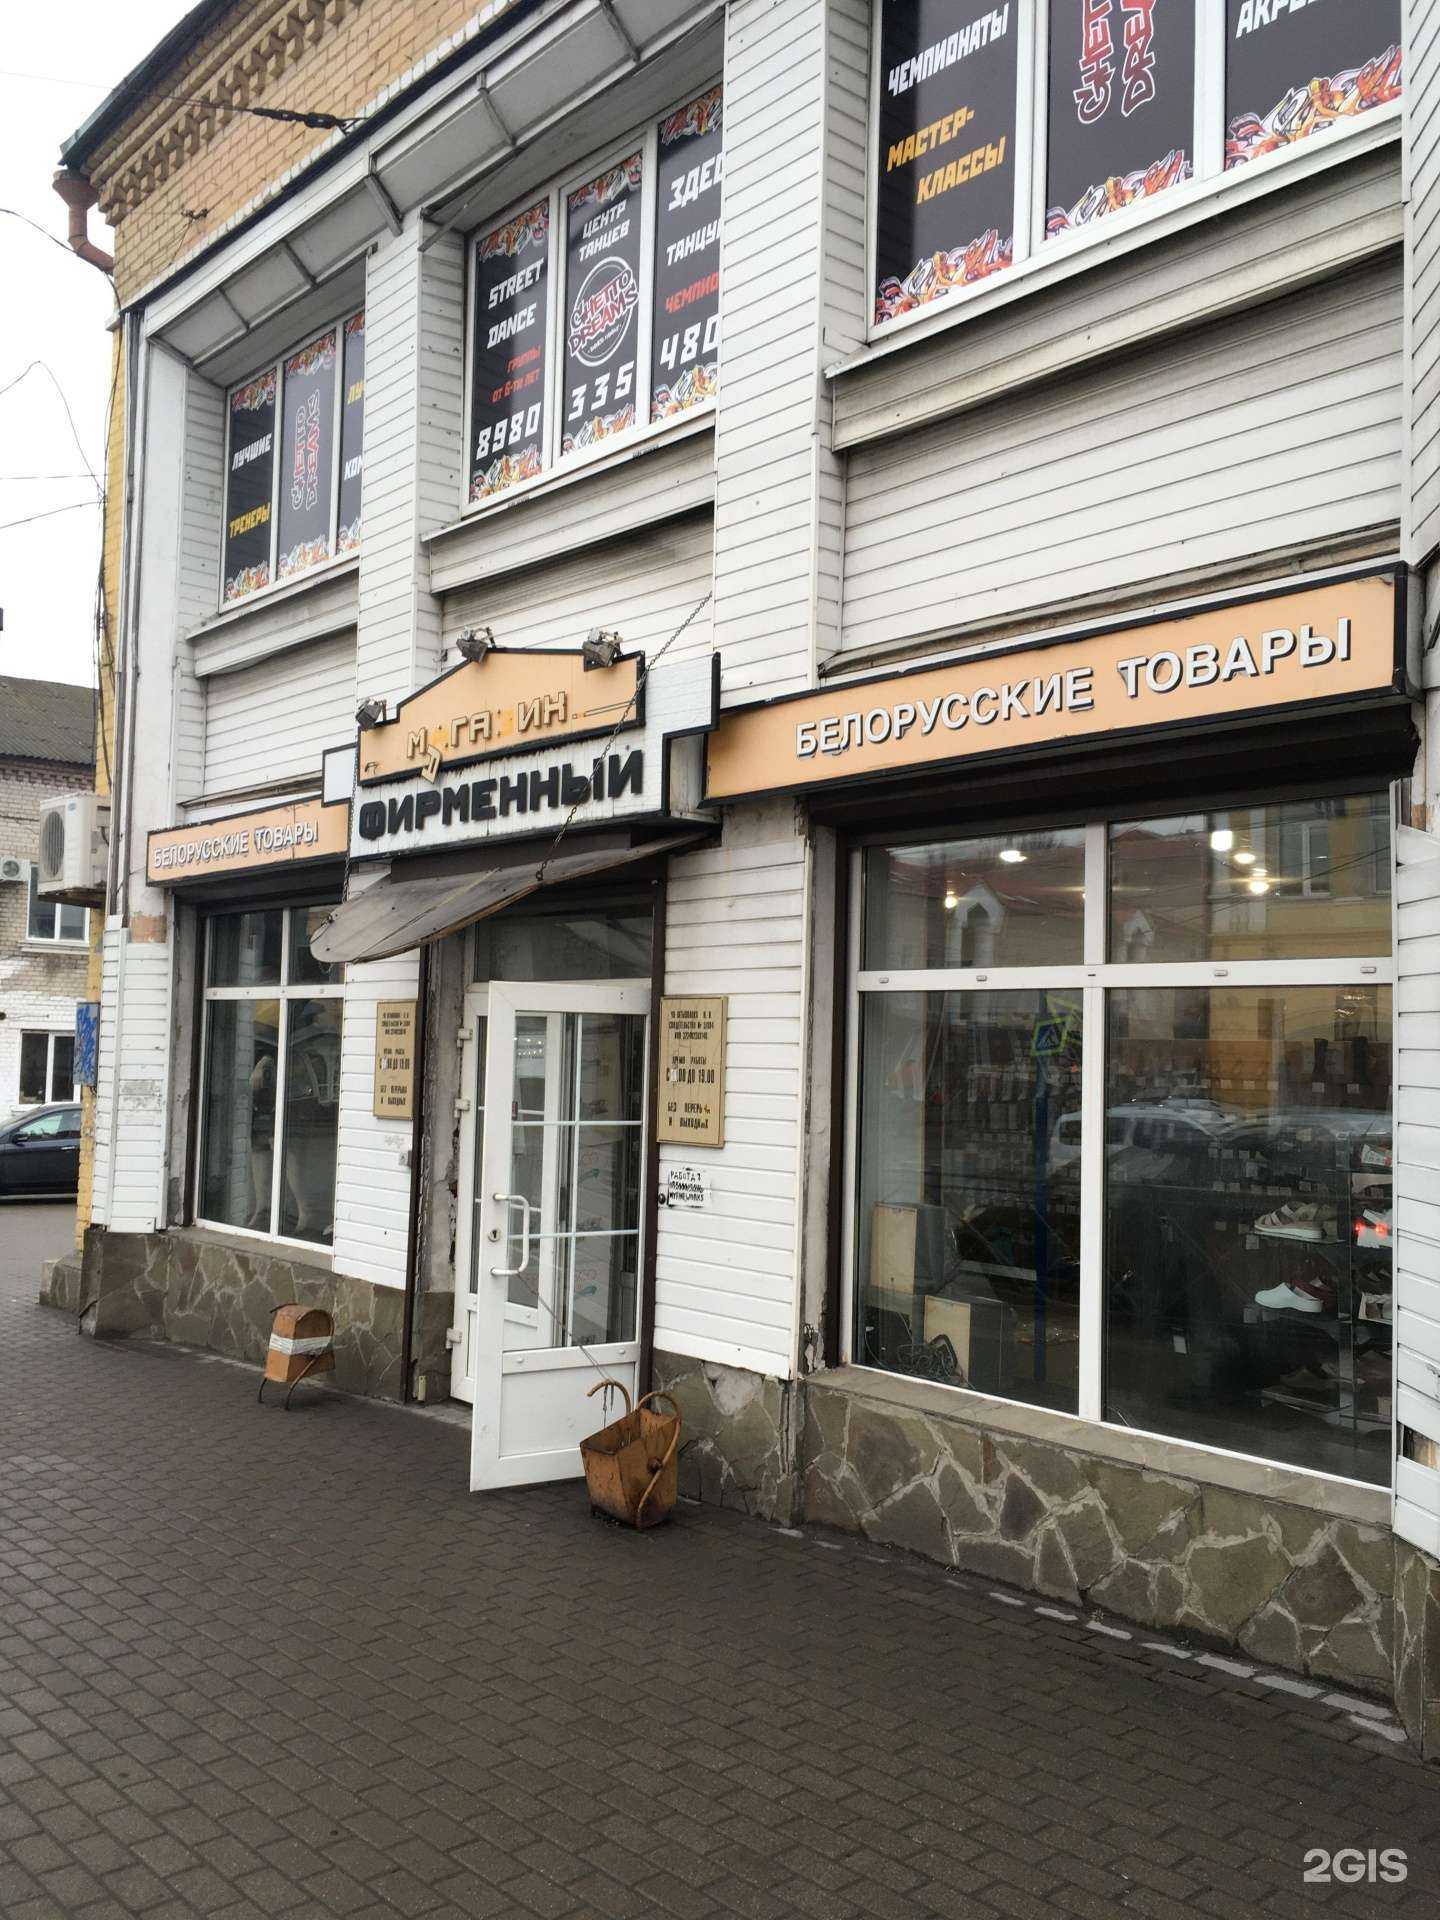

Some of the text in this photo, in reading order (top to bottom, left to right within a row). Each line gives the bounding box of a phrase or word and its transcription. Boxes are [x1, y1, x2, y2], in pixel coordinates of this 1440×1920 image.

[1235, 0, 1317, 39] АКР
[888, 2, 1009, 97] ЧЕМПИОНАТЫ
[886, 106, 974, 172] МАСТЕР-
[916, 136, 1006, 205] КЛАССЫ
[579, 219, 631, 262] ТАНЦЕВ
[582, 199, 627, 239] ЦЕНТР
[488, 257, 544, 310] STREET
[487, 302, 537, 349] DANCE
[660, 313, 719, 370] 480
[568, 359, 634, 421] 335
[232, 432, 272, 471] ЛУЧШИЕ
[476, 401, 542, 460] 8980
[229, 501, 271, 539] ТРЕНЕРЫ
[795, 617, 1351, 758] БЕЛОРУССКИЕ ТОВАРЫ
[407, 691, 568, 758] МГАИН
[153, 820, 319, 869] БЕЛОРУССКИЕ ТОВАРЫ
